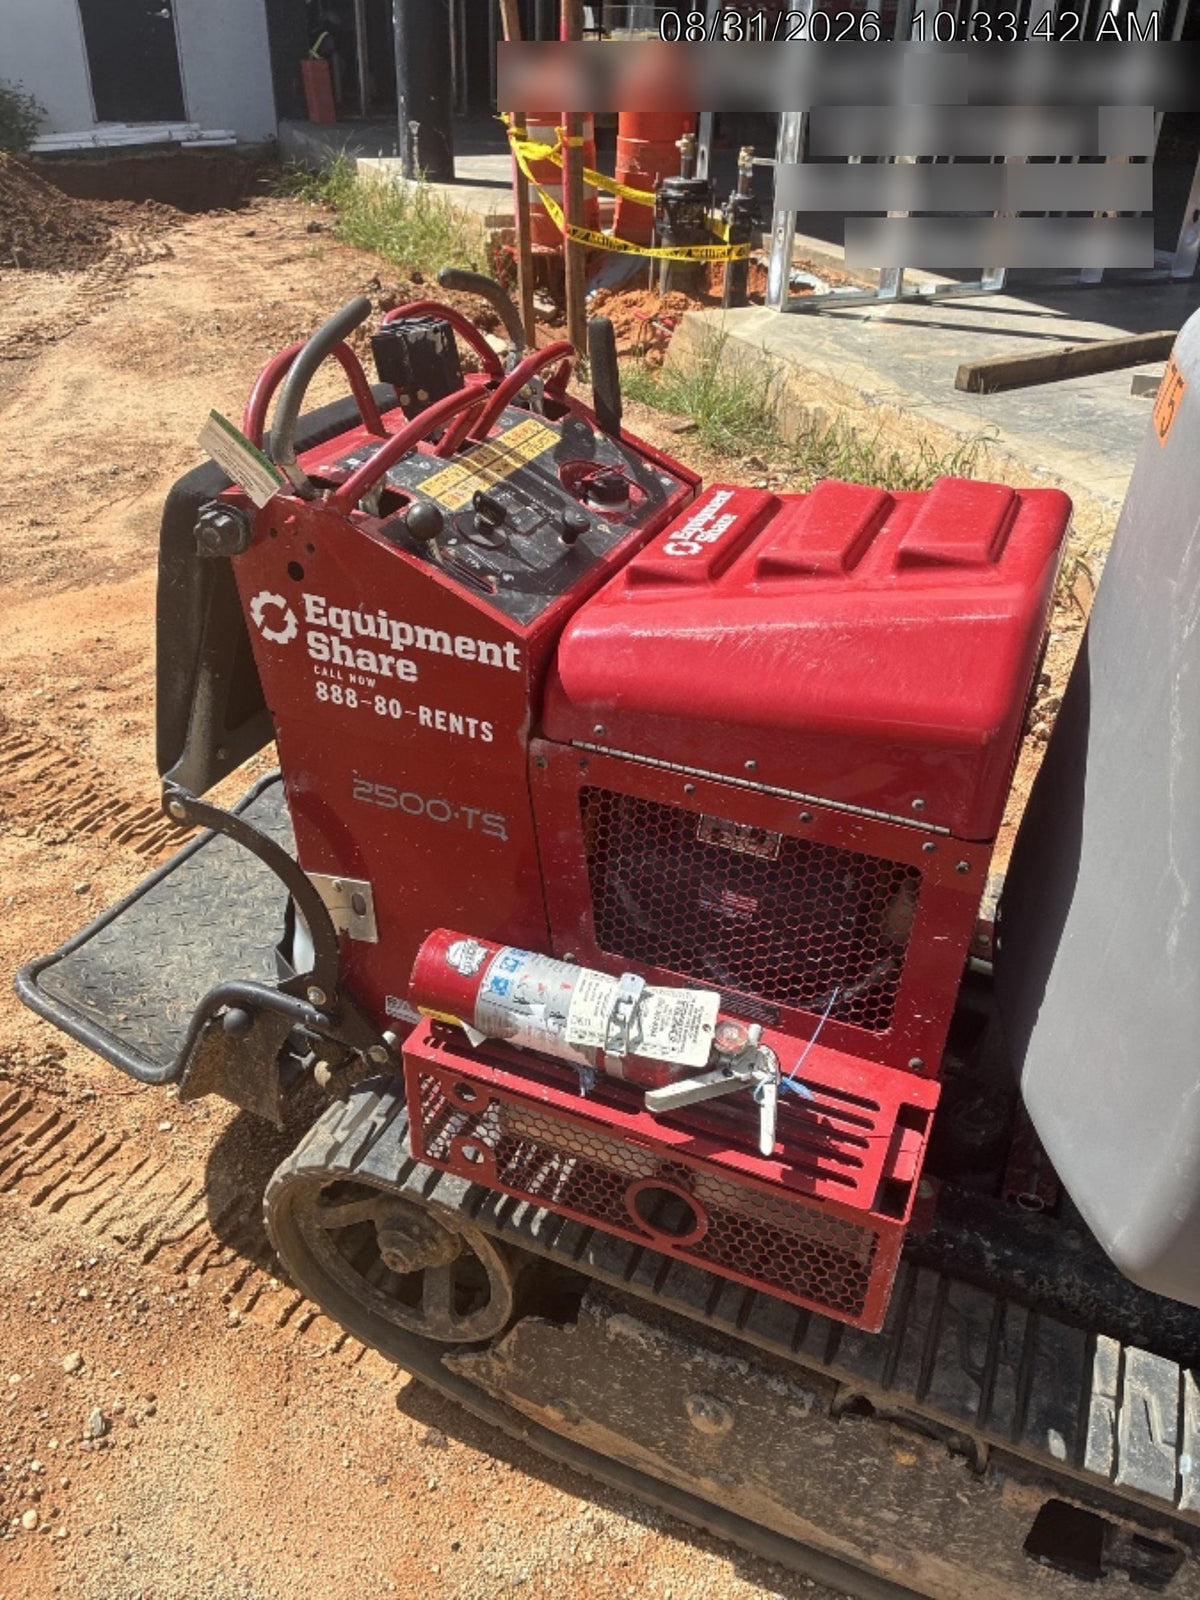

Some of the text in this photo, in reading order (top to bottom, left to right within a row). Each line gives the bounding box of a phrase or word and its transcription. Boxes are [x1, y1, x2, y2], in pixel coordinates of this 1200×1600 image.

[668, 490, 735, 541] Equipment
[694, 513, 738, 543] Share
[302, 592, 521, 672] Equipment
[306, 630, 418, 683] Share
[313, 664, 376, 688] CALL NOW
[315, 682, 494, 743] 888-80-RENTS
